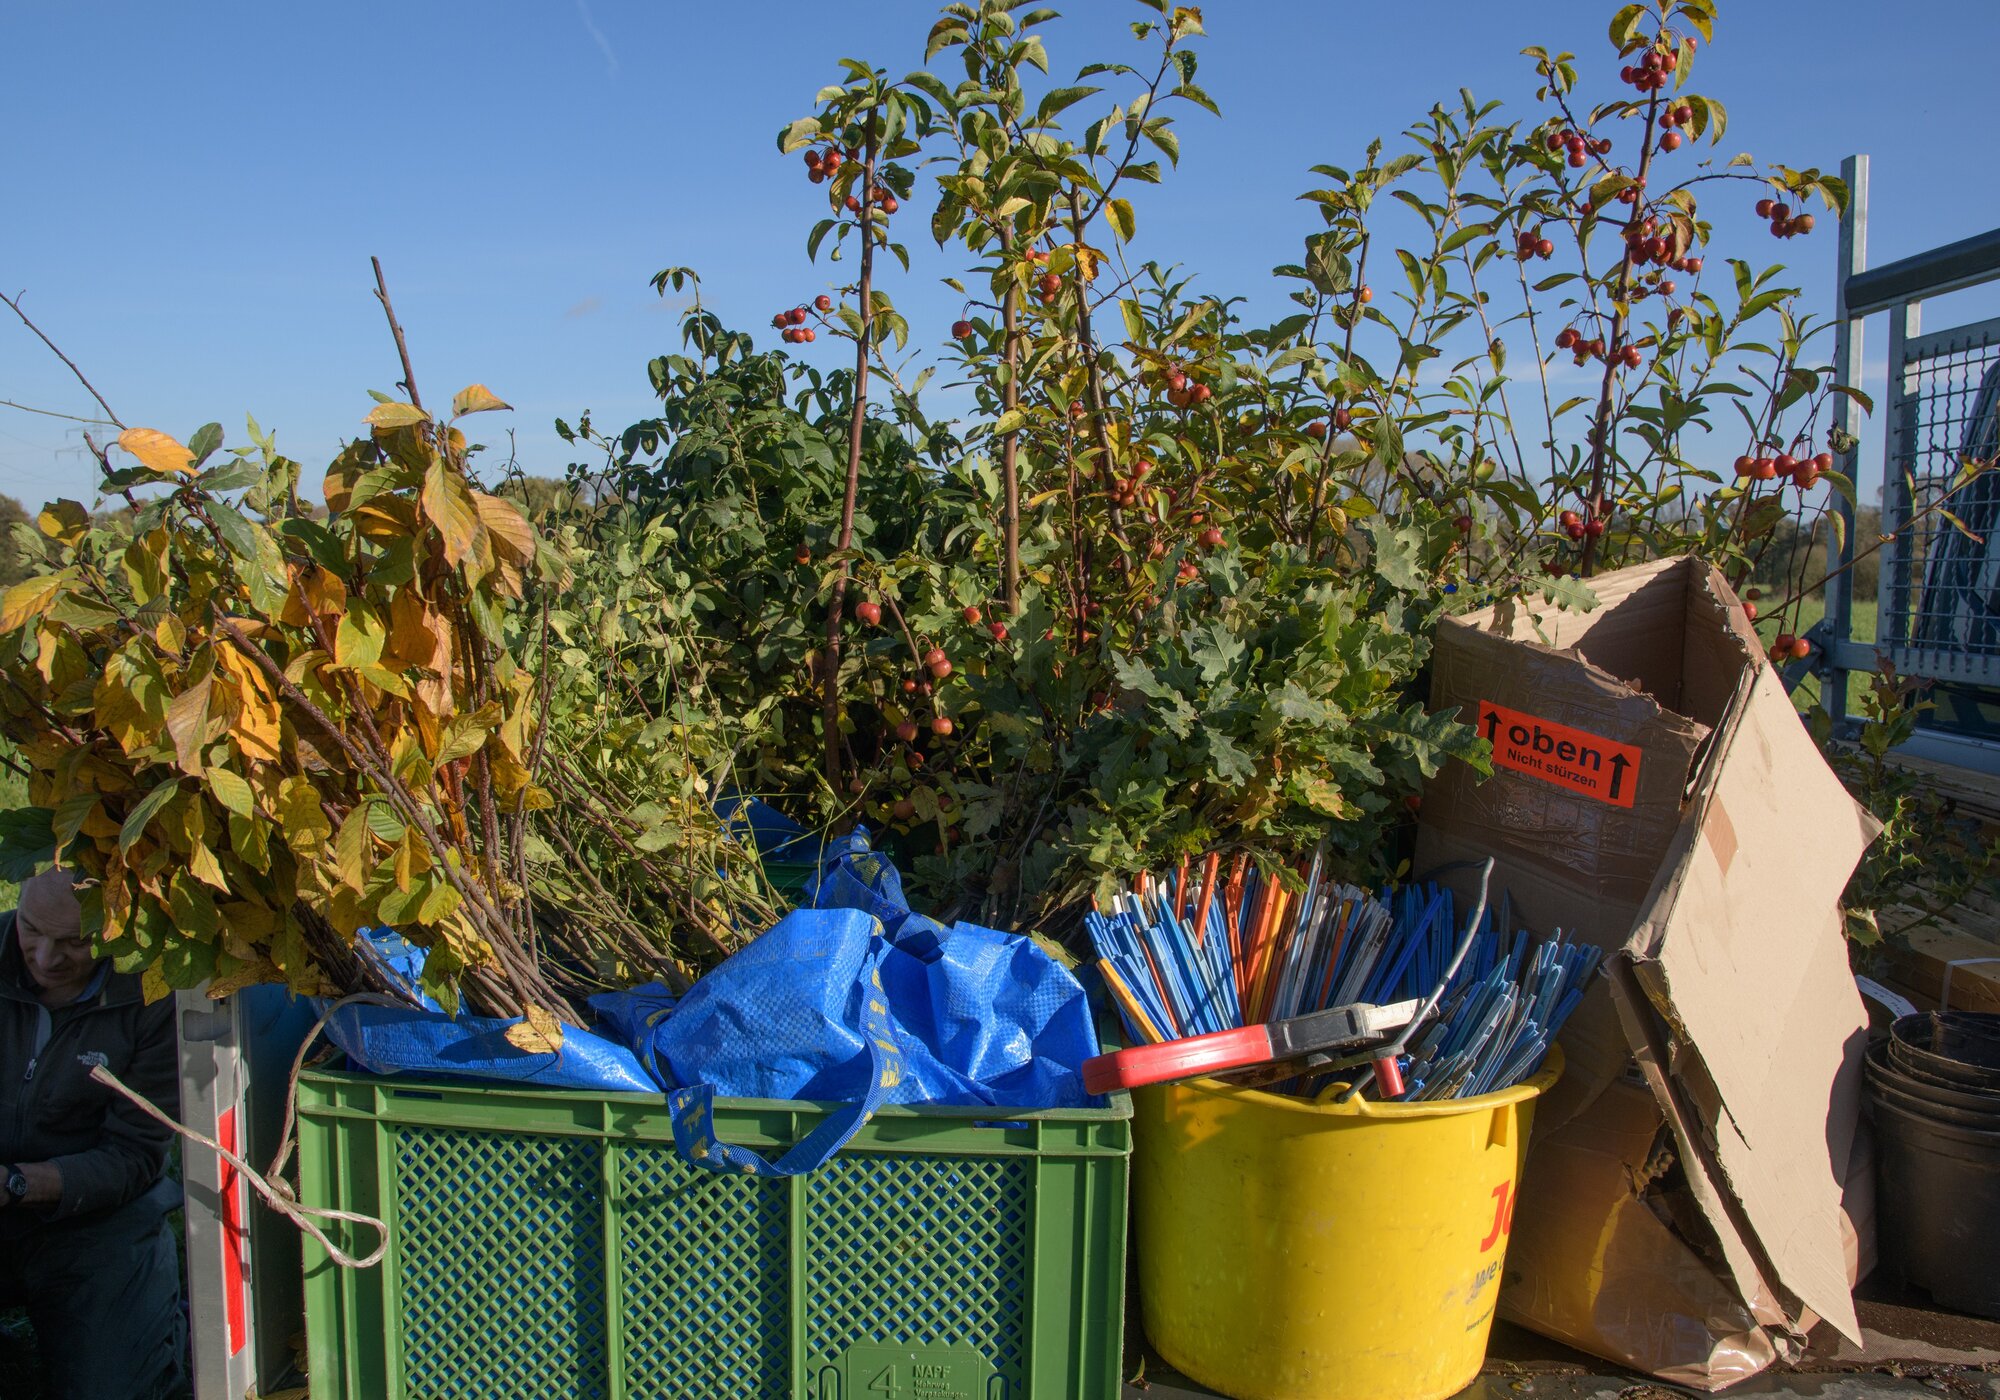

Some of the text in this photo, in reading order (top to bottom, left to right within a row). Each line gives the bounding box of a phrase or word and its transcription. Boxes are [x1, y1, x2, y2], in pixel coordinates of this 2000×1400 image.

[1508, 725, 1601, 772] oben
[1507, 748, 1597, 789] Nicht stürzen
[868, 1364, 902, 1400] 4
[913, 1364, 952, 1379] NAPF
